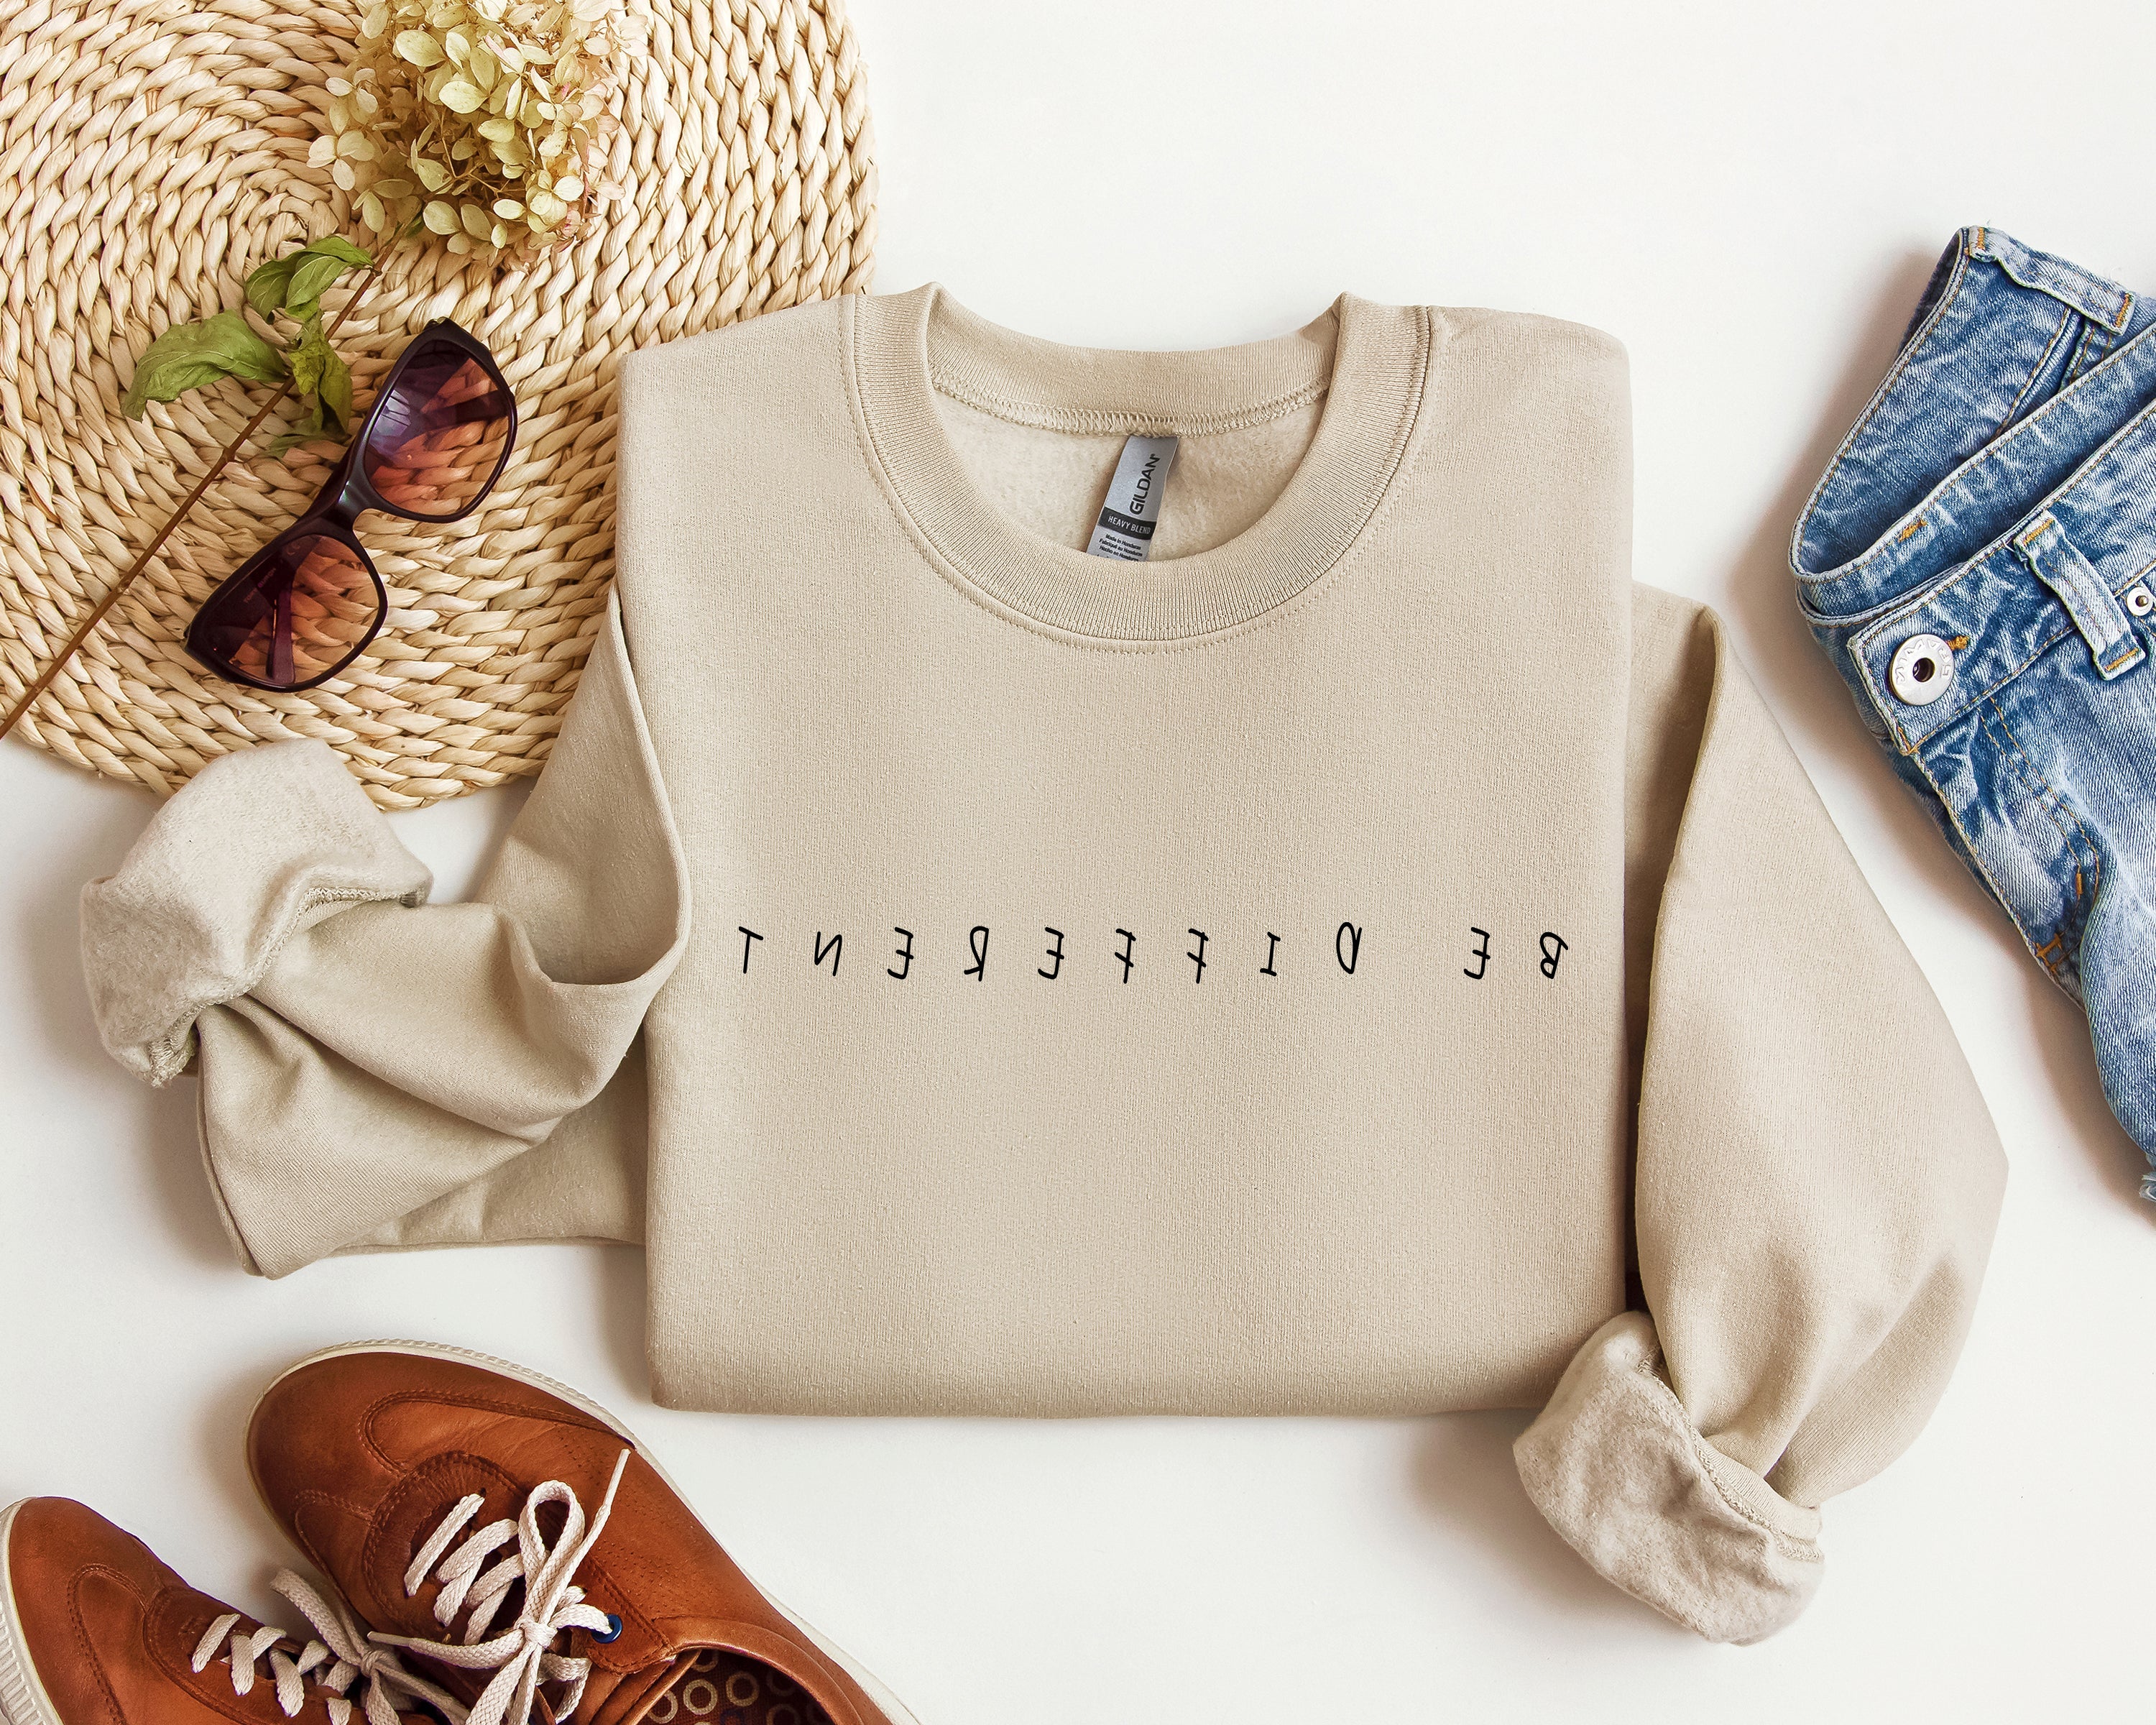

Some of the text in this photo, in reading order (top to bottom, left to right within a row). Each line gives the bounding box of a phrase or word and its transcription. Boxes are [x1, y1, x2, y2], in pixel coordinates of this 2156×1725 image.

[1129, 454, 1161, 515] GILDAN
[1107, 515, 1151, 534] HEAVY BLEND
